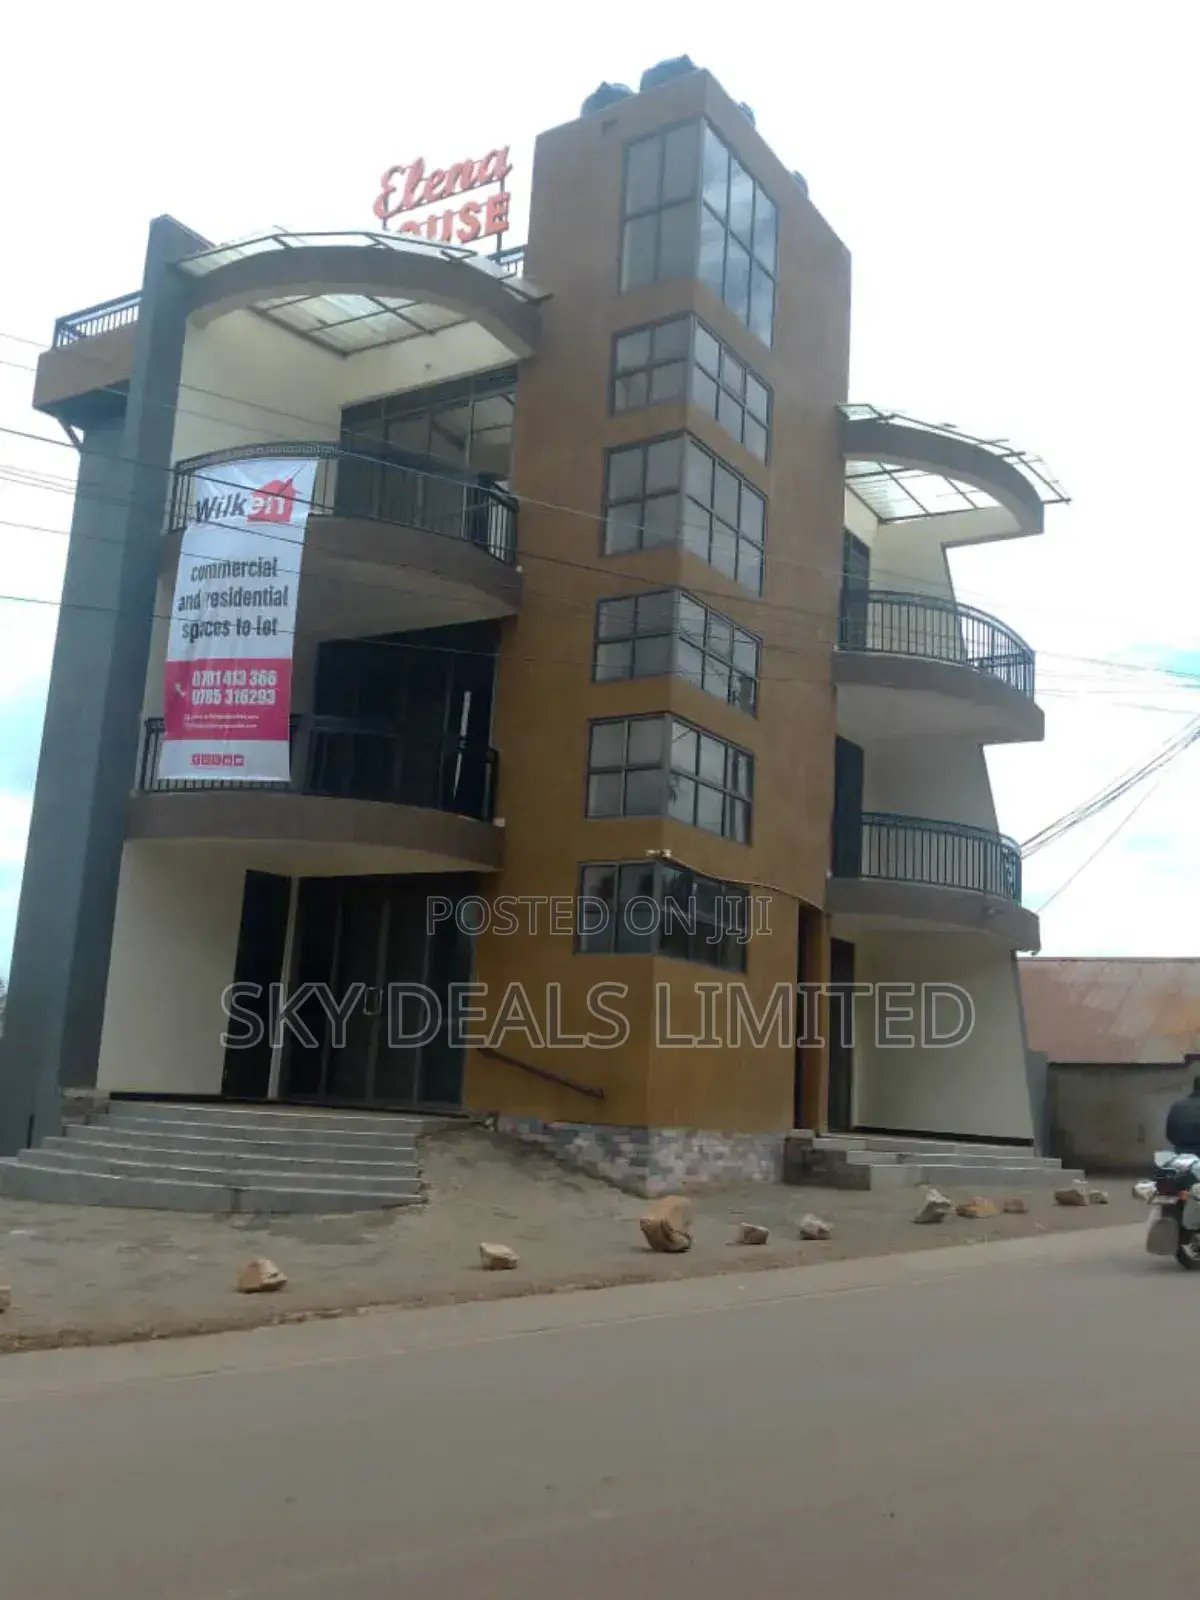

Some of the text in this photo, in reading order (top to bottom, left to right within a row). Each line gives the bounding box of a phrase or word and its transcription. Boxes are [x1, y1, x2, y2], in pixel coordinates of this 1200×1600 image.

[373, 145, 512, 219] Elena
[196, 491, 285, 523] Wilken
[190, 556, 278, 582] commercial
[178, 585, 289, 612] and residential
[236, 616, 251, 637] to
[192, 669, 221, 687] 0701
[223, 669, 247, 687] 413
